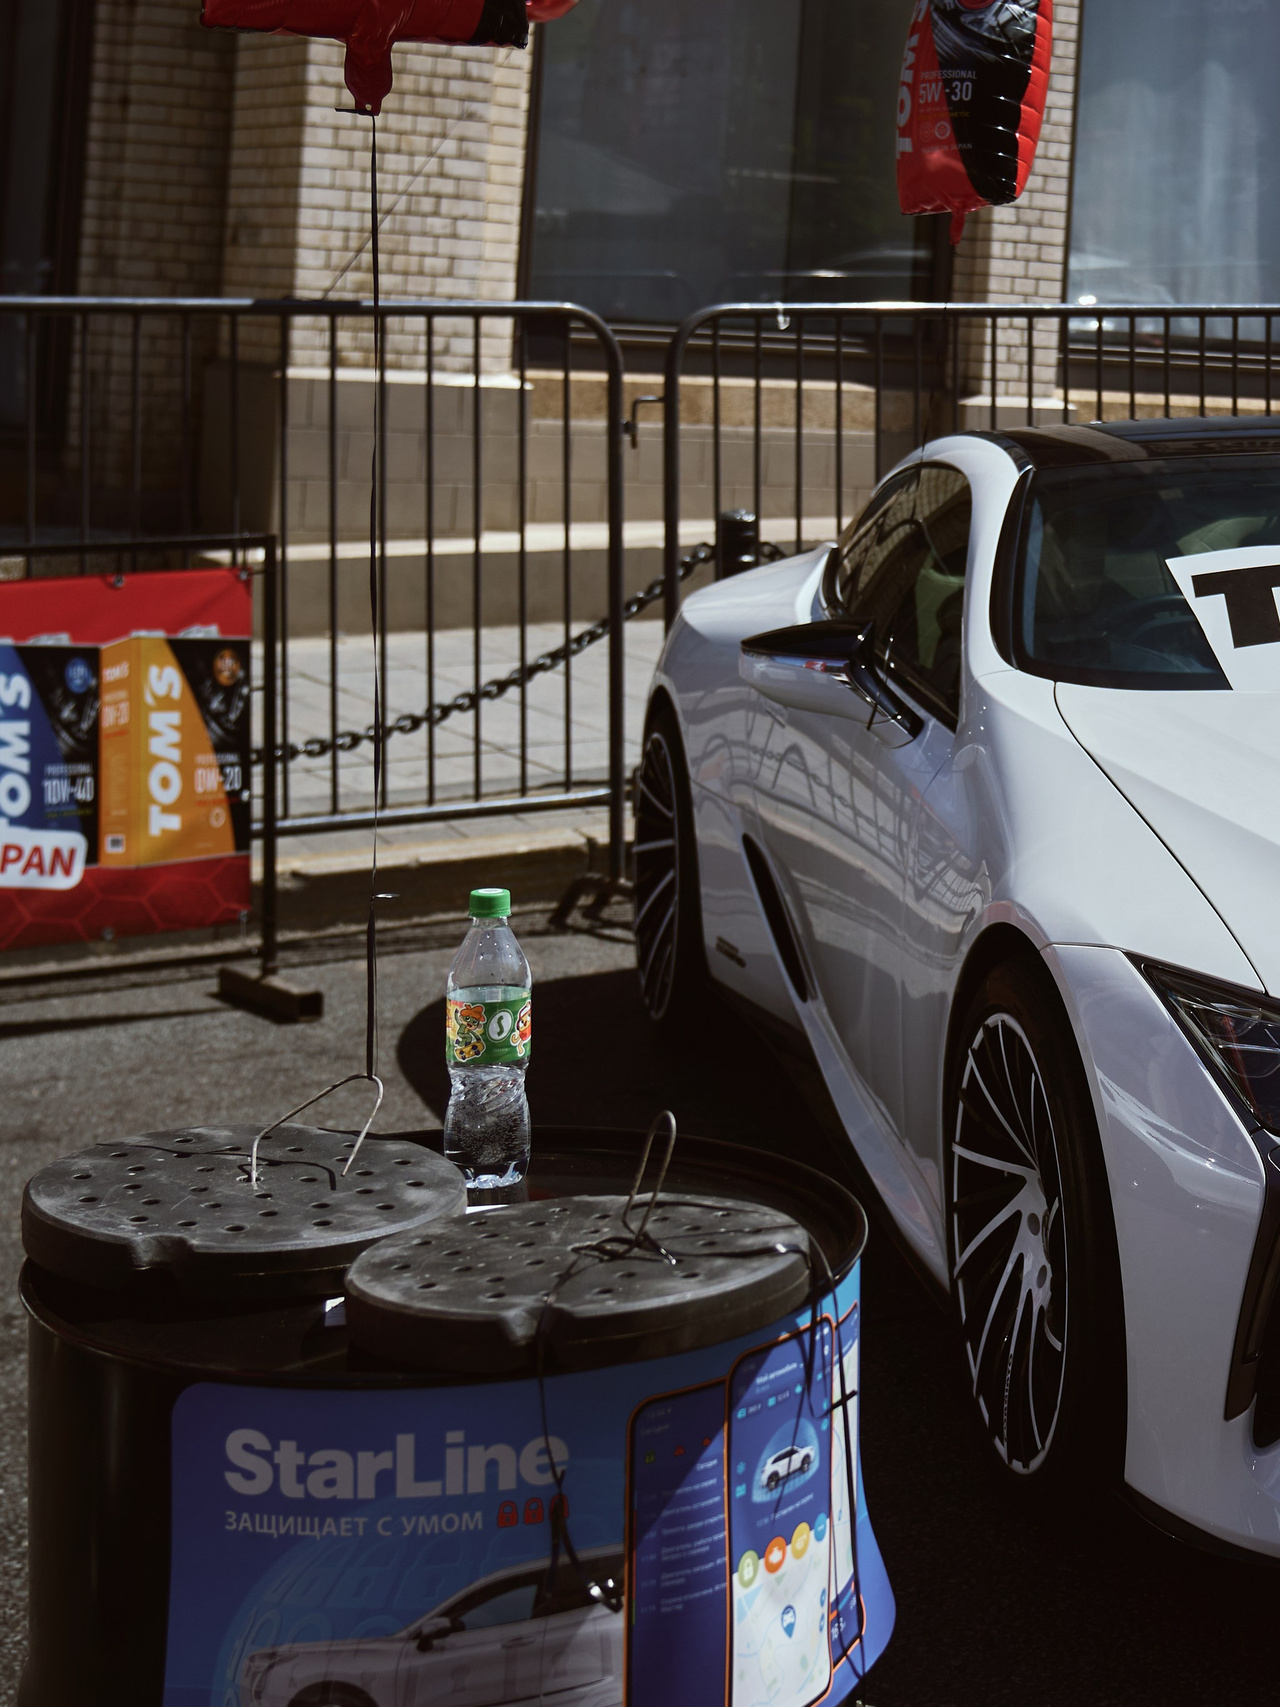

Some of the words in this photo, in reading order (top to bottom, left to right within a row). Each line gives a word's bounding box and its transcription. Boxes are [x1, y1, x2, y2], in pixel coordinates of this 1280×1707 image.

[920, 69, 978, 81] PROFESSIONAL
[144, 664, 183, 837] TOM'S
[41, 775, 95, 806] 10W-40
[193, 764, 242, 794] 0W-20
[224, 1428, 570, 1501] StarLine
[224, 1510, 369, 1540] ЗАЩИЩАЕТ
[376, 1516, 393, 1537] С
[401, 1510, 484, 1537] УМОМ
